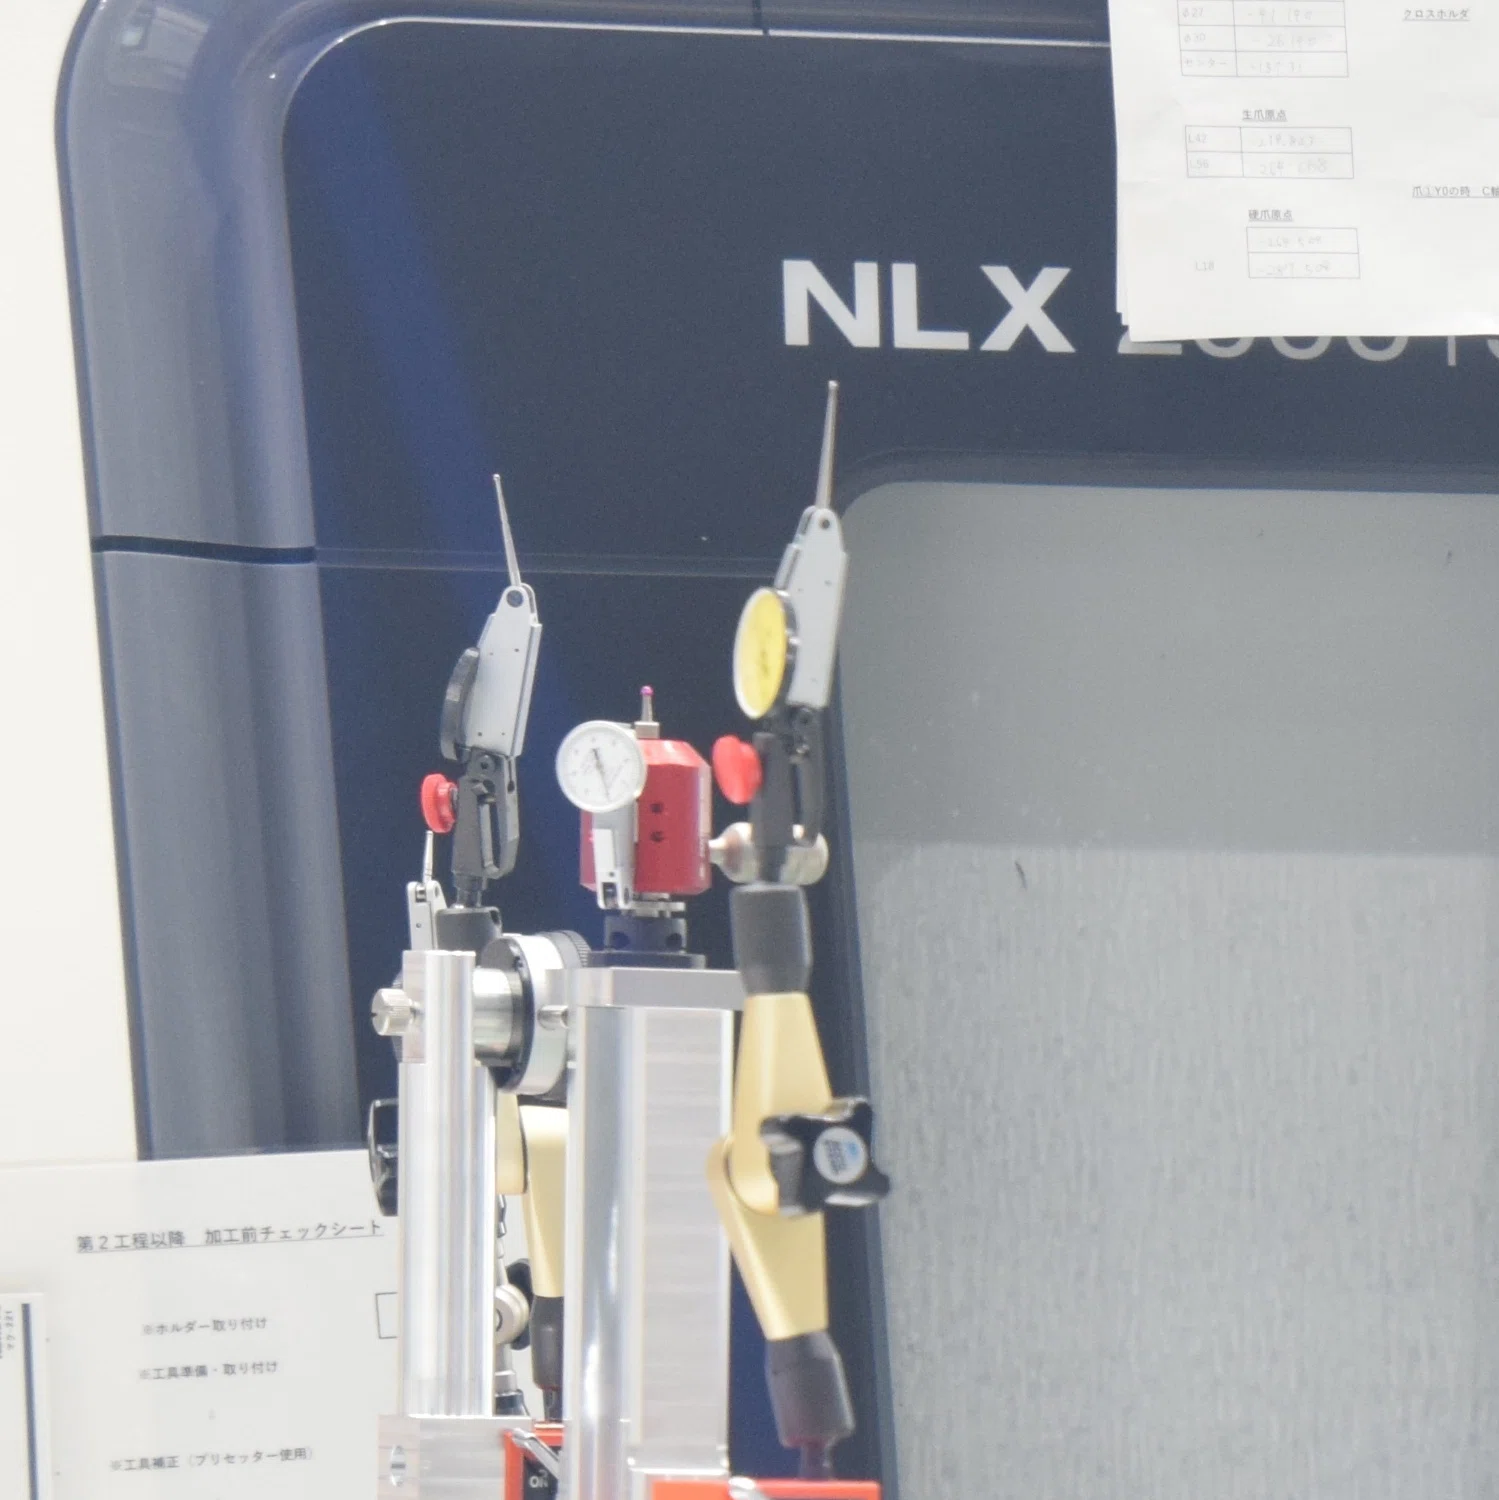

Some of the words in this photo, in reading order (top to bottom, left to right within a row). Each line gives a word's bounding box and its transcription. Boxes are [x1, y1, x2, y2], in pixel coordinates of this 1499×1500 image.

[782, 259, 1076, 353] NLX
[204, 1221, 383, 1246] 加工前チェックシート
